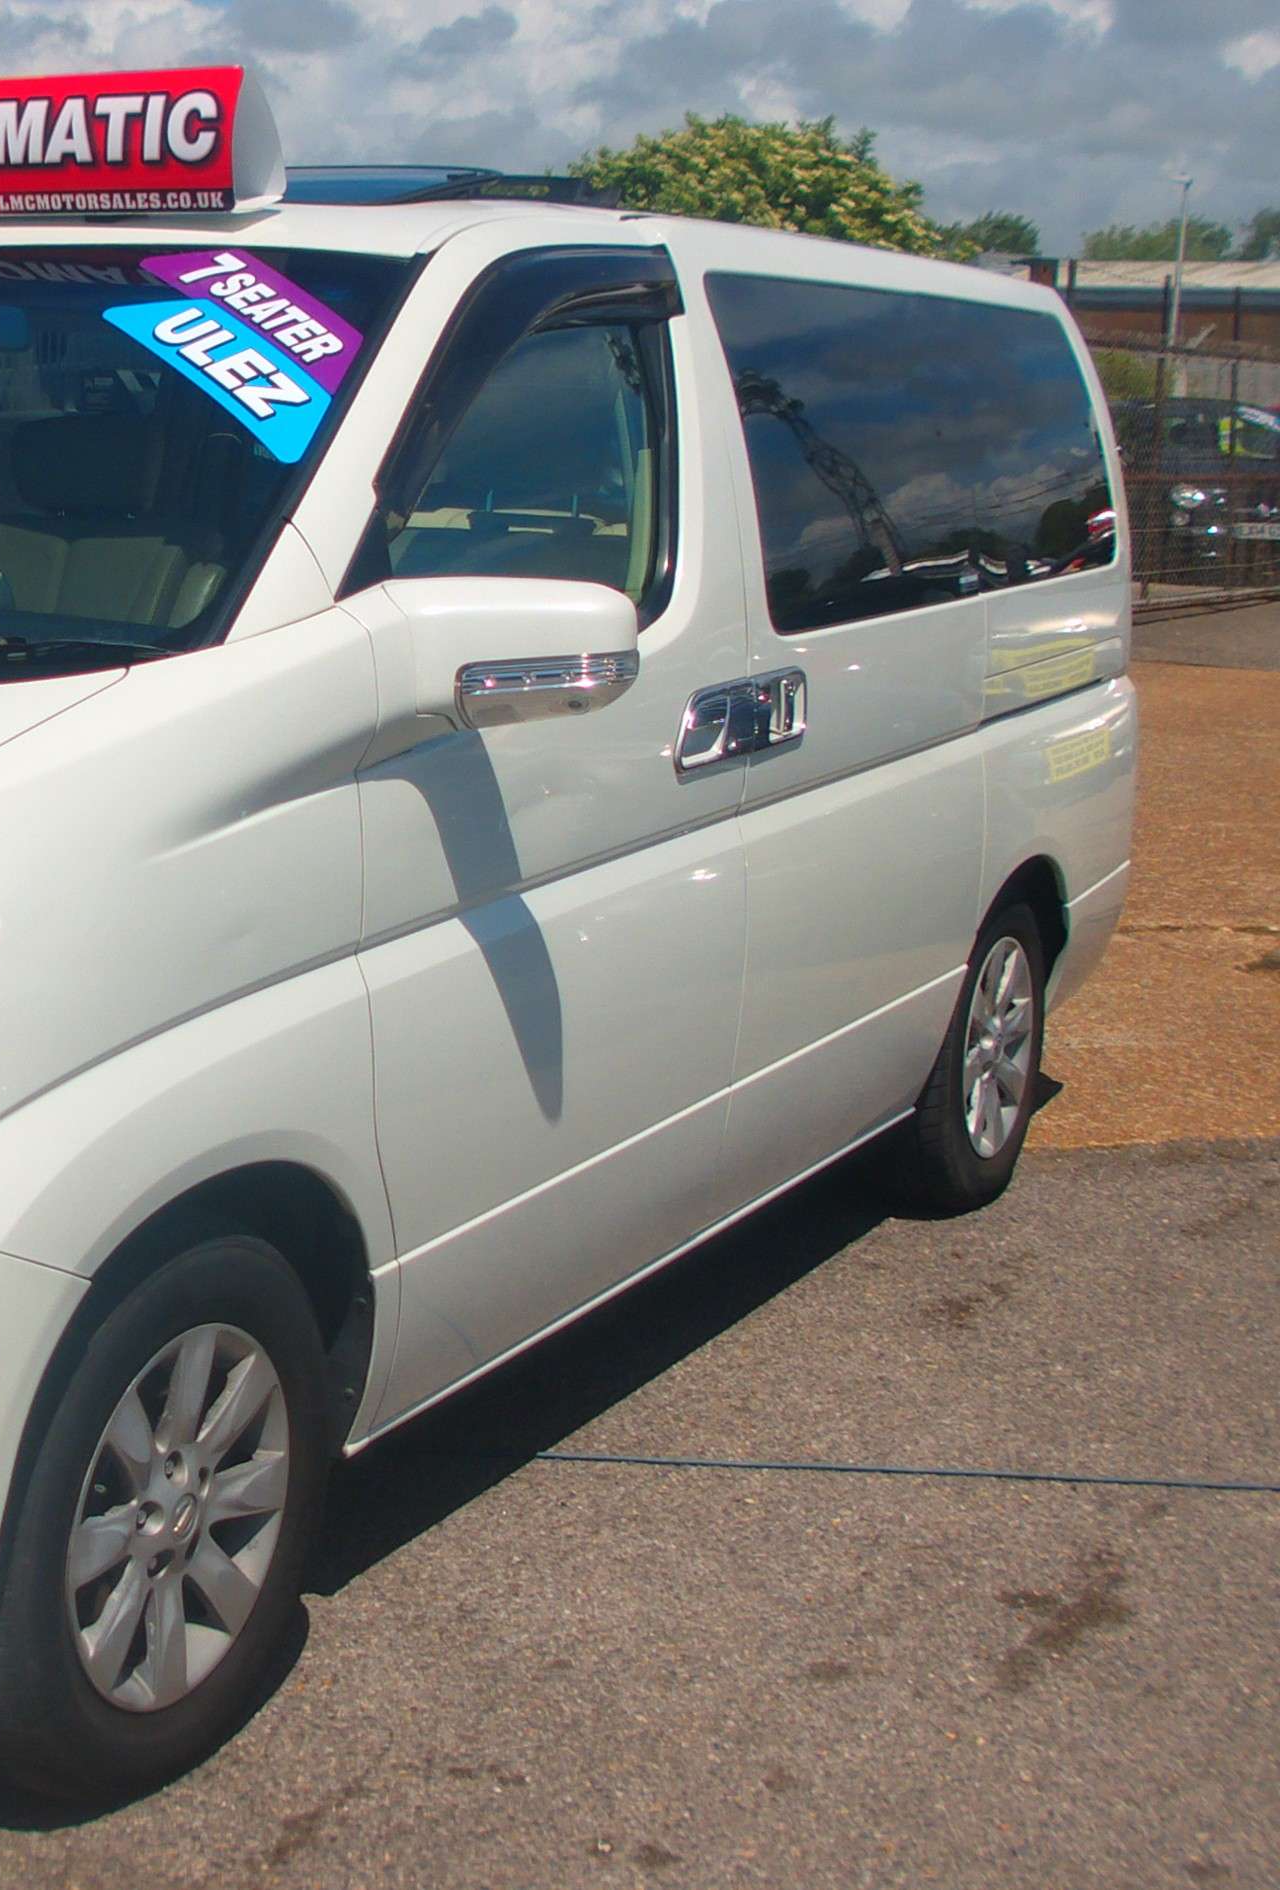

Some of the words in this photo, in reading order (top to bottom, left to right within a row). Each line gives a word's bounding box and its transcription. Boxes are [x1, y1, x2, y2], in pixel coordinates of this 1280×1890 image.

[178, 251, 247, 284] 7
[152, 306, 312, 420] ULEZ
[209, 272, 344, 363] SEATER
